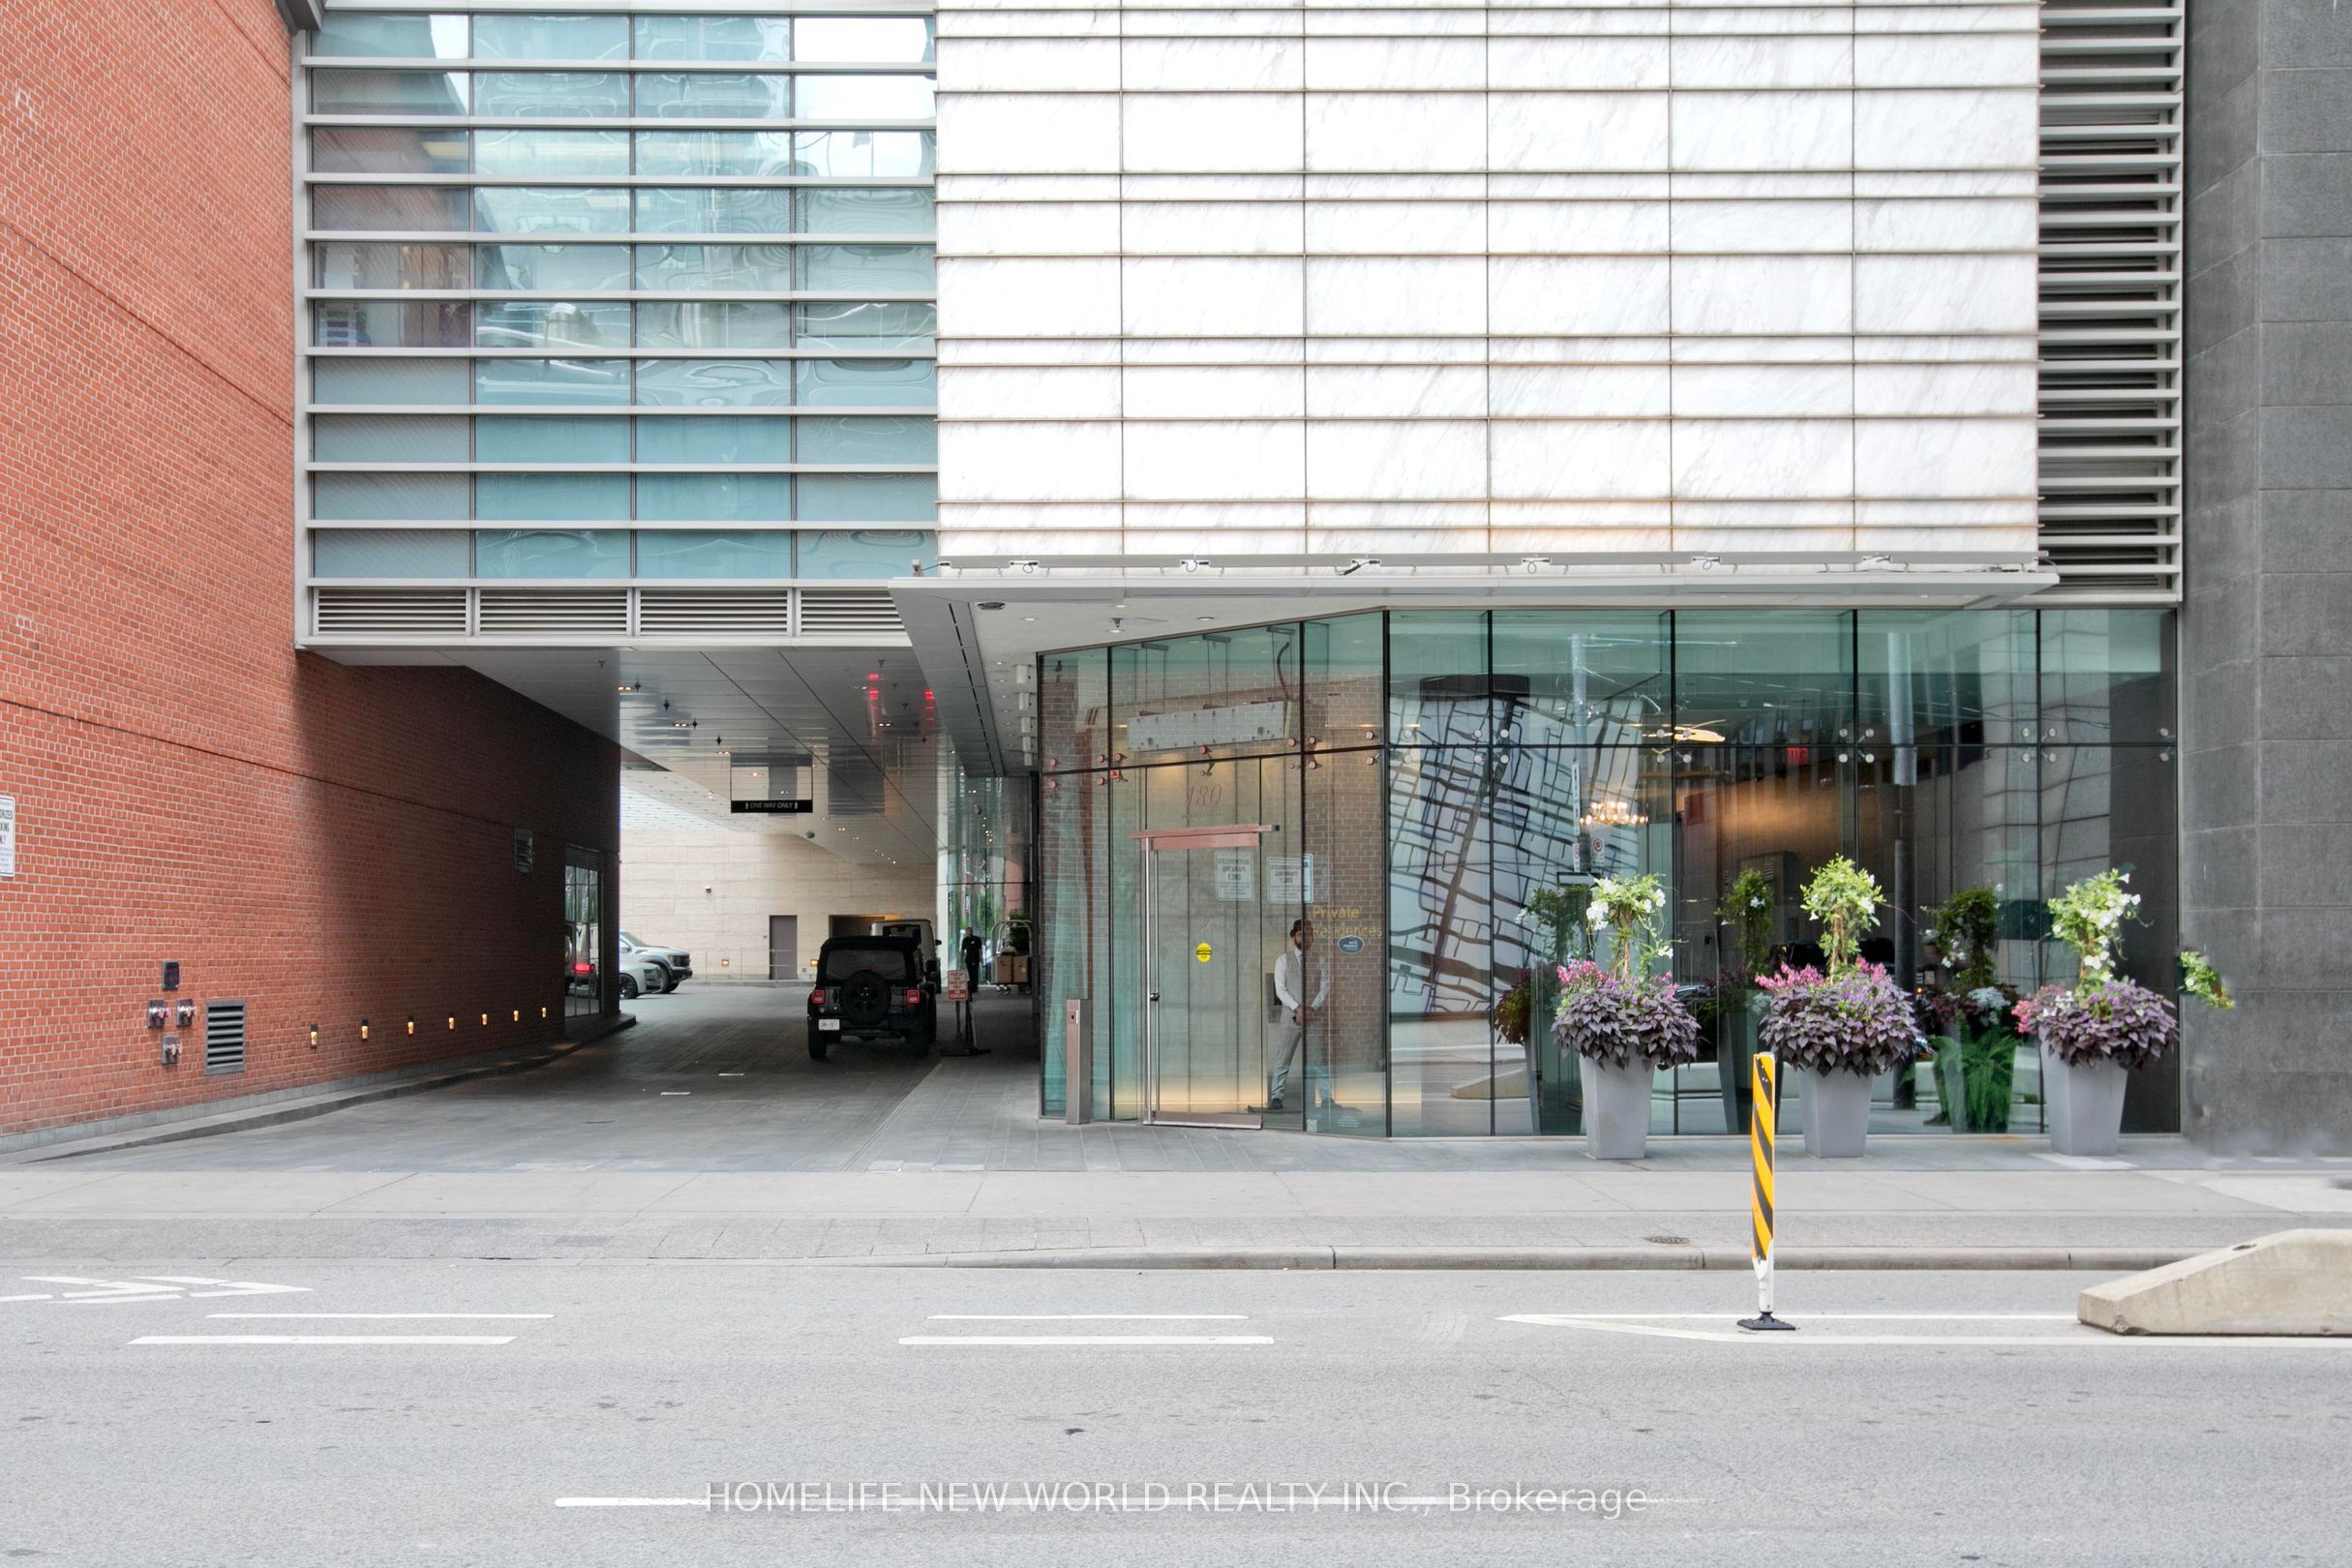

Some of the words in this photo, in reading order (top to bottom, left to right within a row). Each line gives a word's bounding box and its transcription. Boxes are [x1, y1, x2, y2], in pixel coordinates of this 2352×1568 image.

[1185, 784, 1222, 806] 180
[1312, 905, 1360, 919] Private
[1312, 924, 1383, 937] Residences
